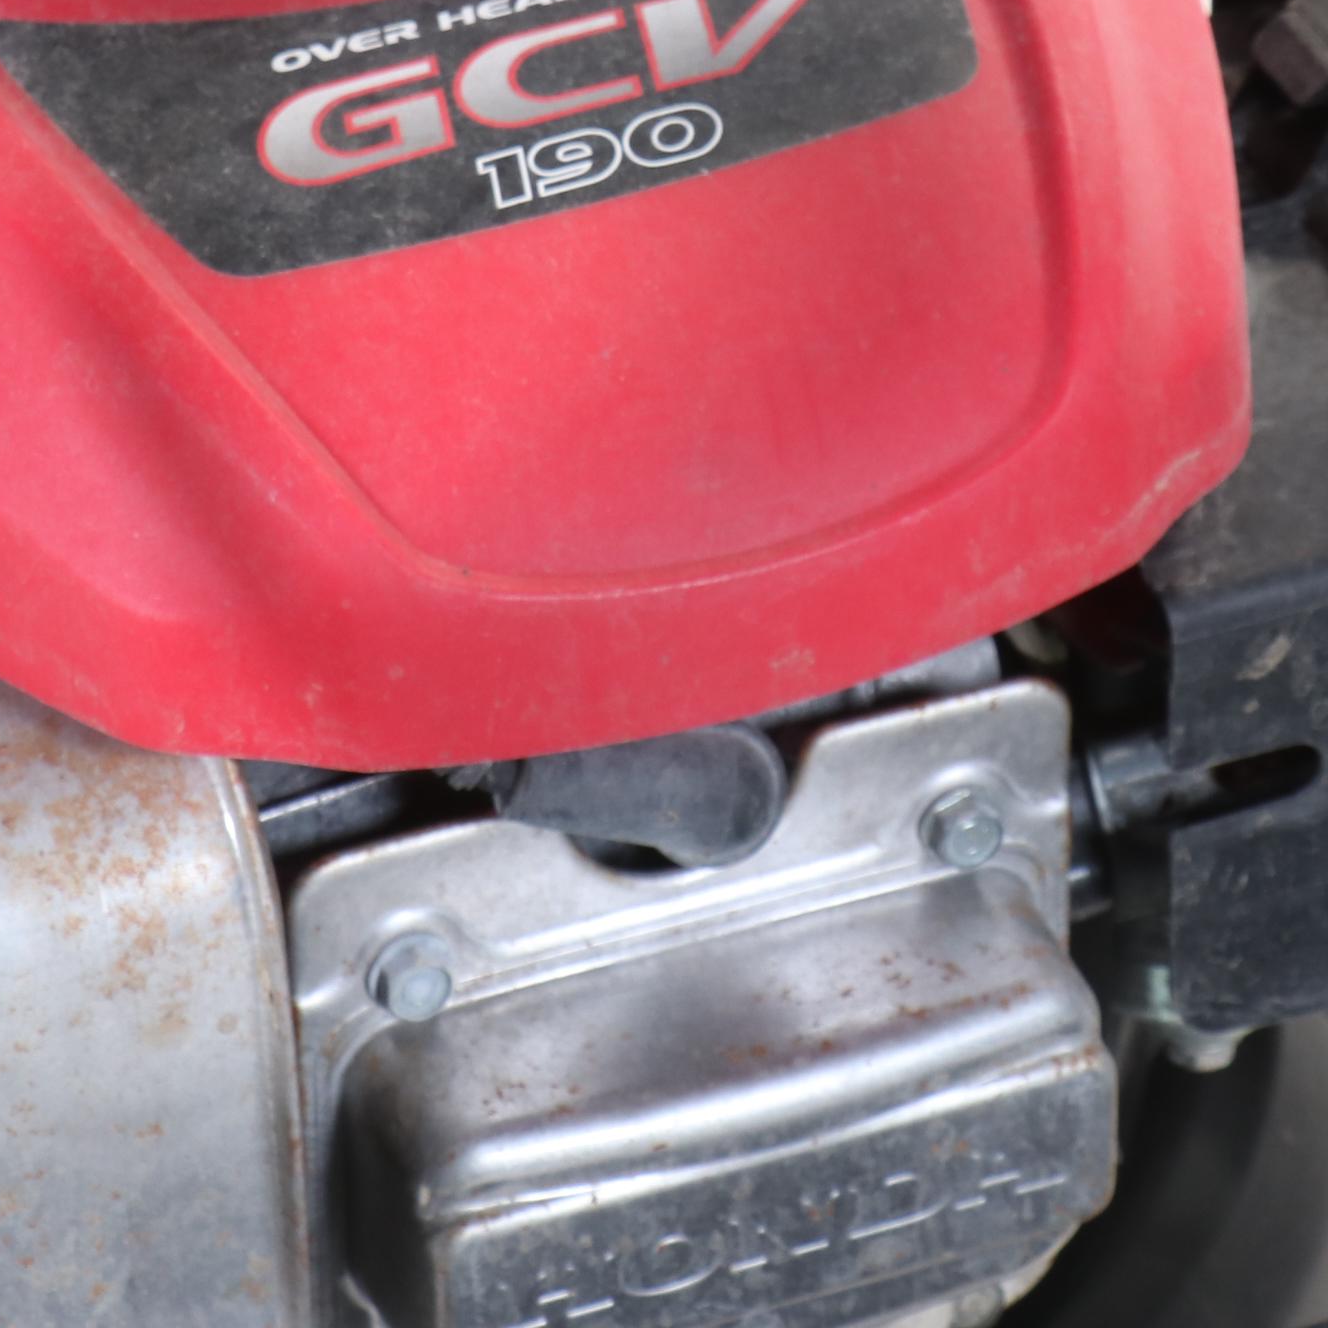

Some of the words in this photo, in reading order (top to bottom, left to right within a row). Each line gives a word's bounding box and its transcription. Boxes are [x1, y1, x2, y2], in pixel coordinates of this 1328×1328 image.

[271, 16, 422, 73] OVER
[475, 102, 724, 210] 190
[498, 1148, 1069, 1328] HONDA
